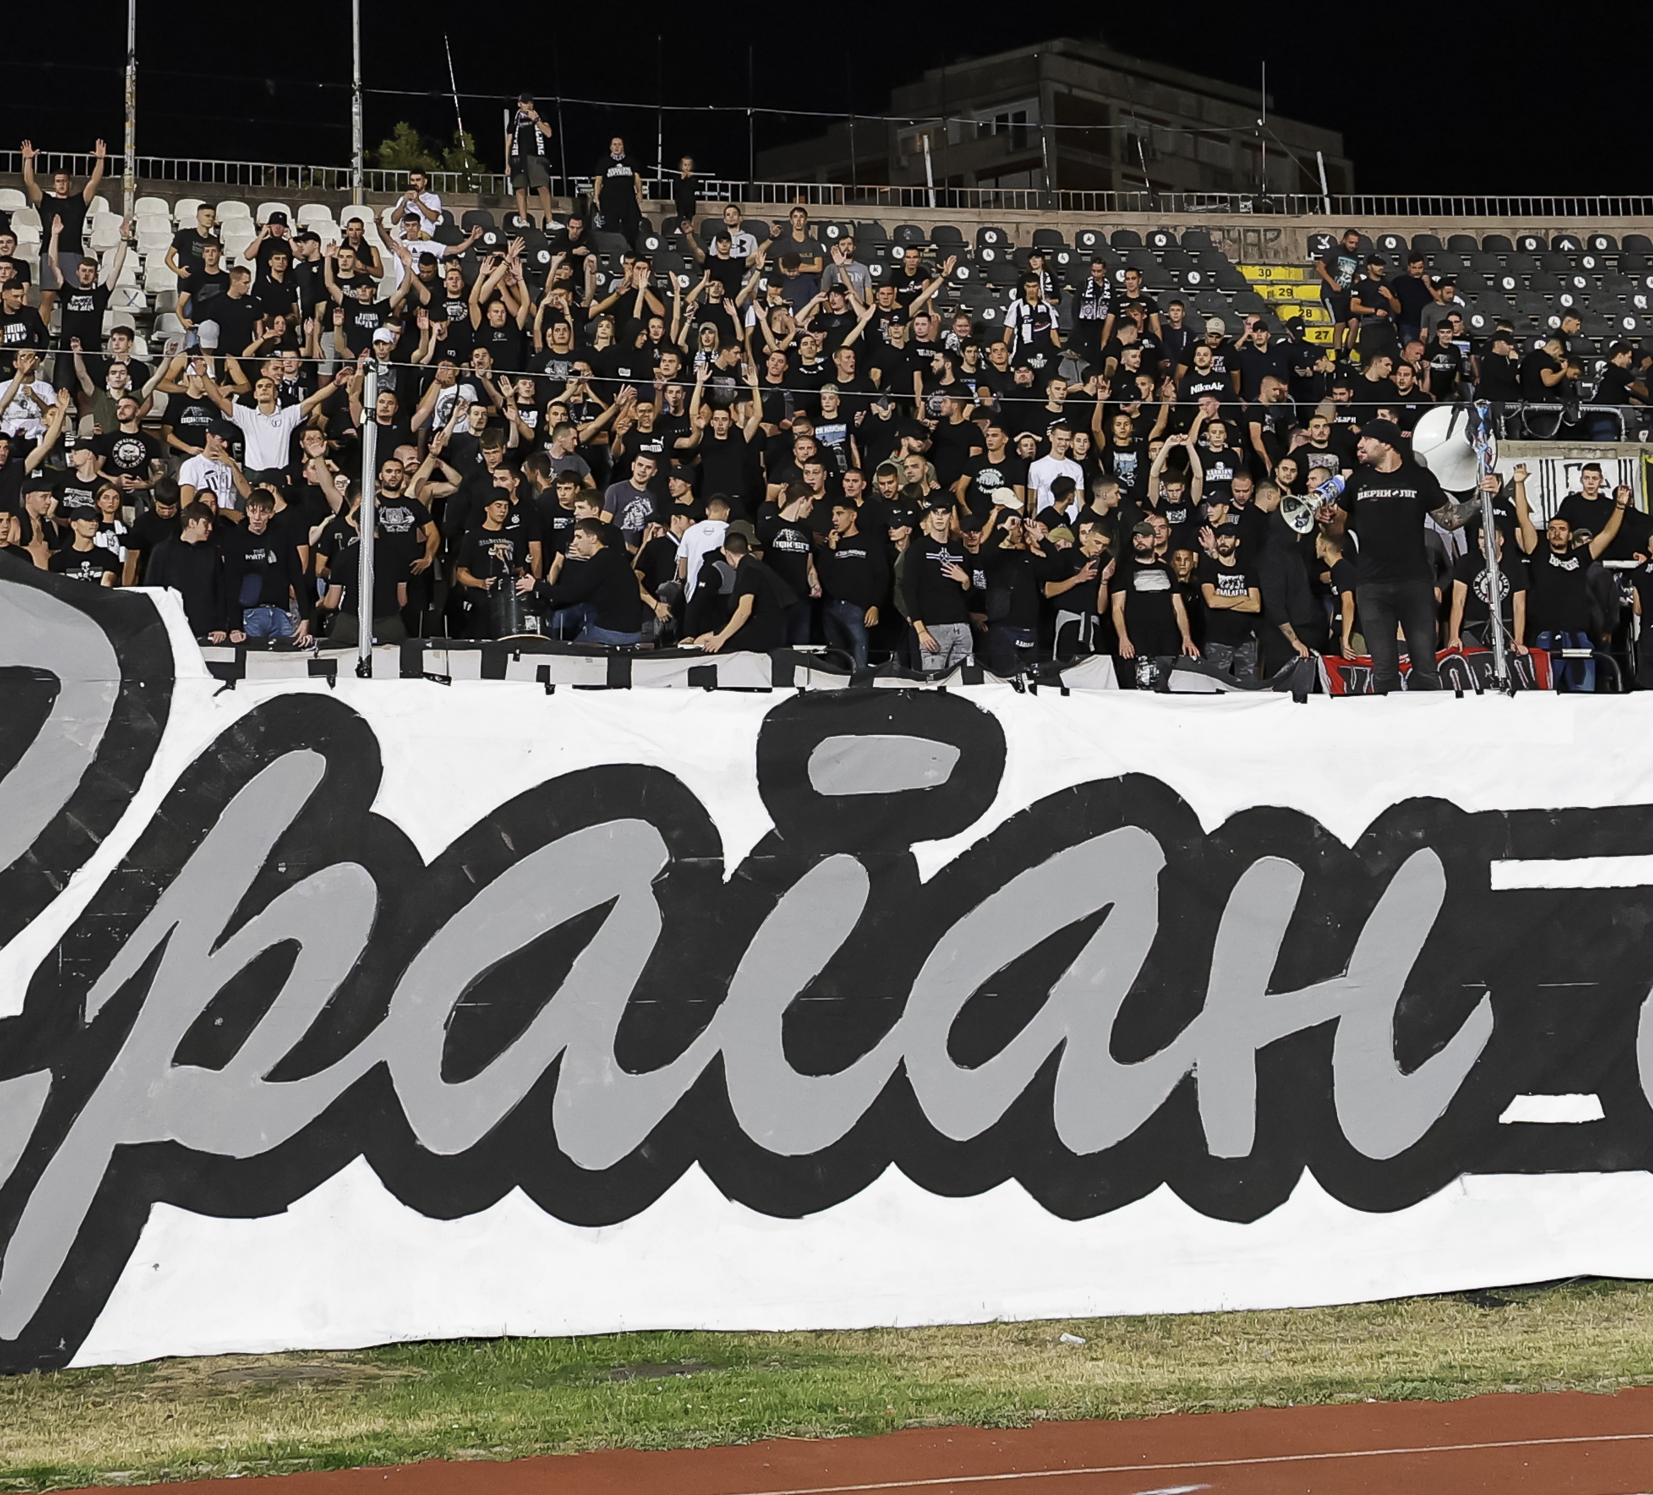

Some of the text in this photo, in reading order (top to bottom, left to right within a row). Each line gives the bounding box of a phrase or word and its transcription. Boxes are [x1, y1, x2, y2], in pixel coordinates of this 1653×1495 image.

[1258, 268, 1272, 278] 30
[1278, 288, 1294, 297] 29
[1299, 308, 1313, 318] 28
[1314, 330, 1330, 340] 27
